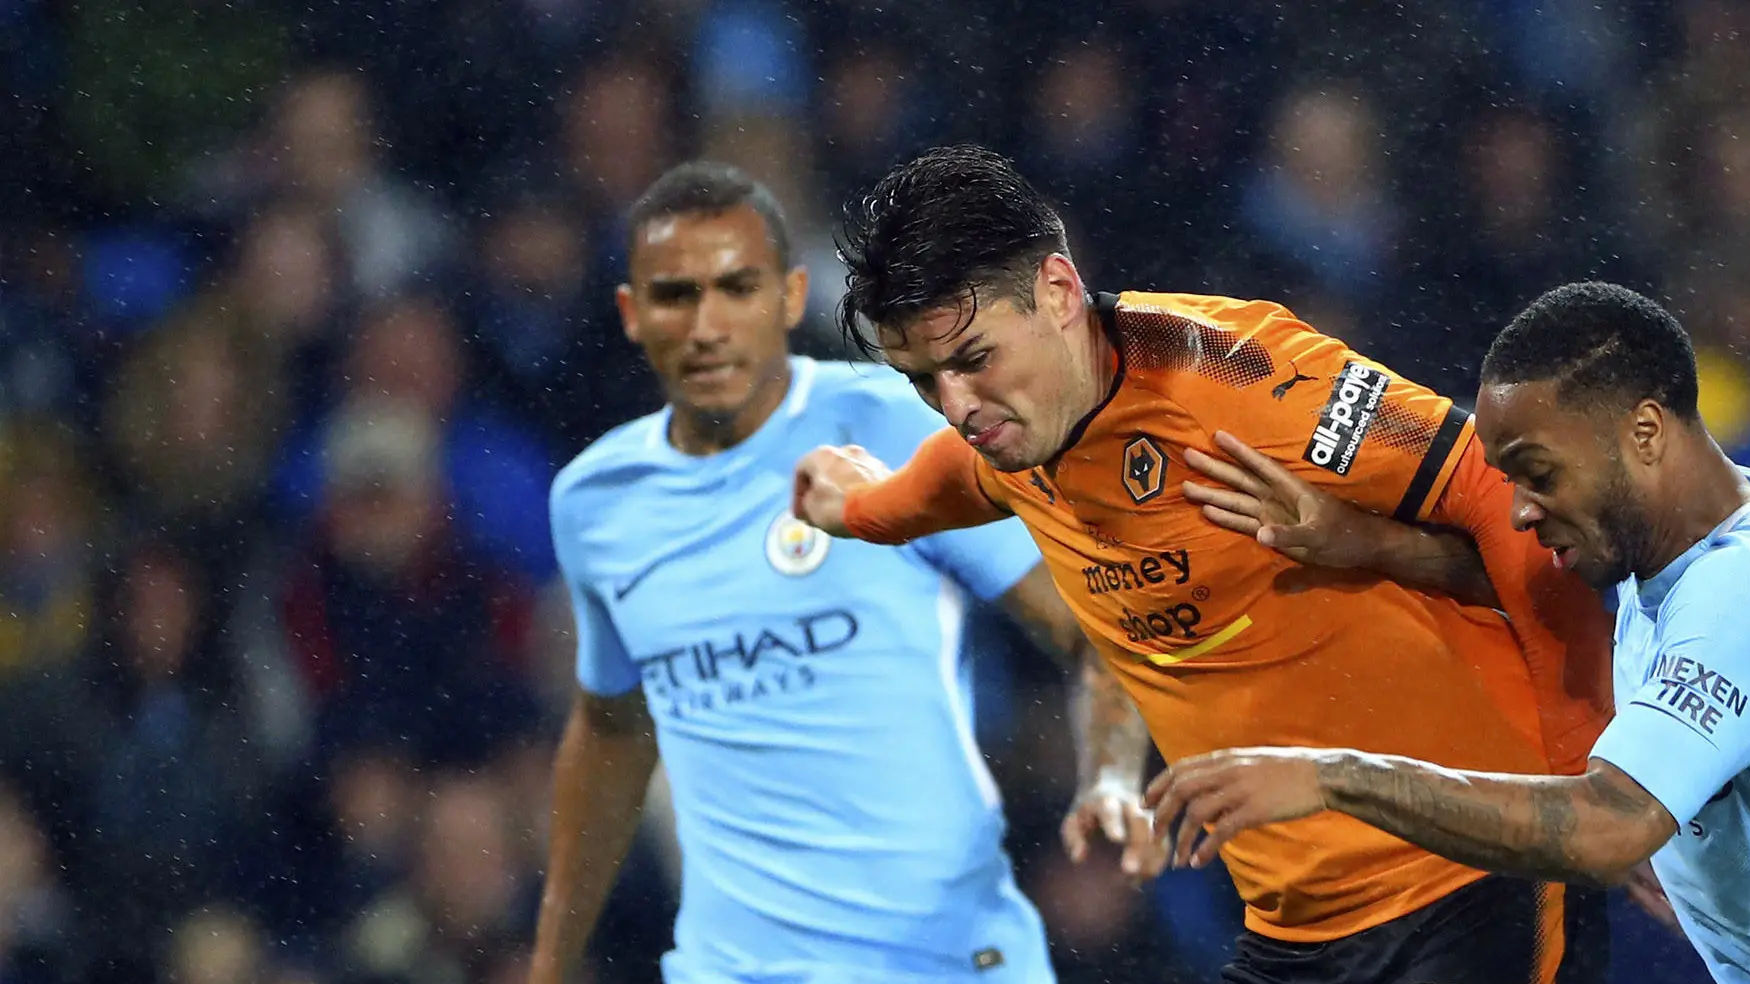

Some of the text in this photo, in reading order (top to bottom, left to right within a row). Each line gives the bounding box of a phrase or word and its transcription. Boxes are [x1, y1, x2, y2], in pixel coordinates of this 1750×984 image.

[1337, 410, 1371, 474] outsourced
[1082, 549, 1190, 594] money
[1119, 602, 1201, 642] shop
[1655, 653, 1748, 717] NEXEN
[1656, 679, 1723, 734] TIRE
